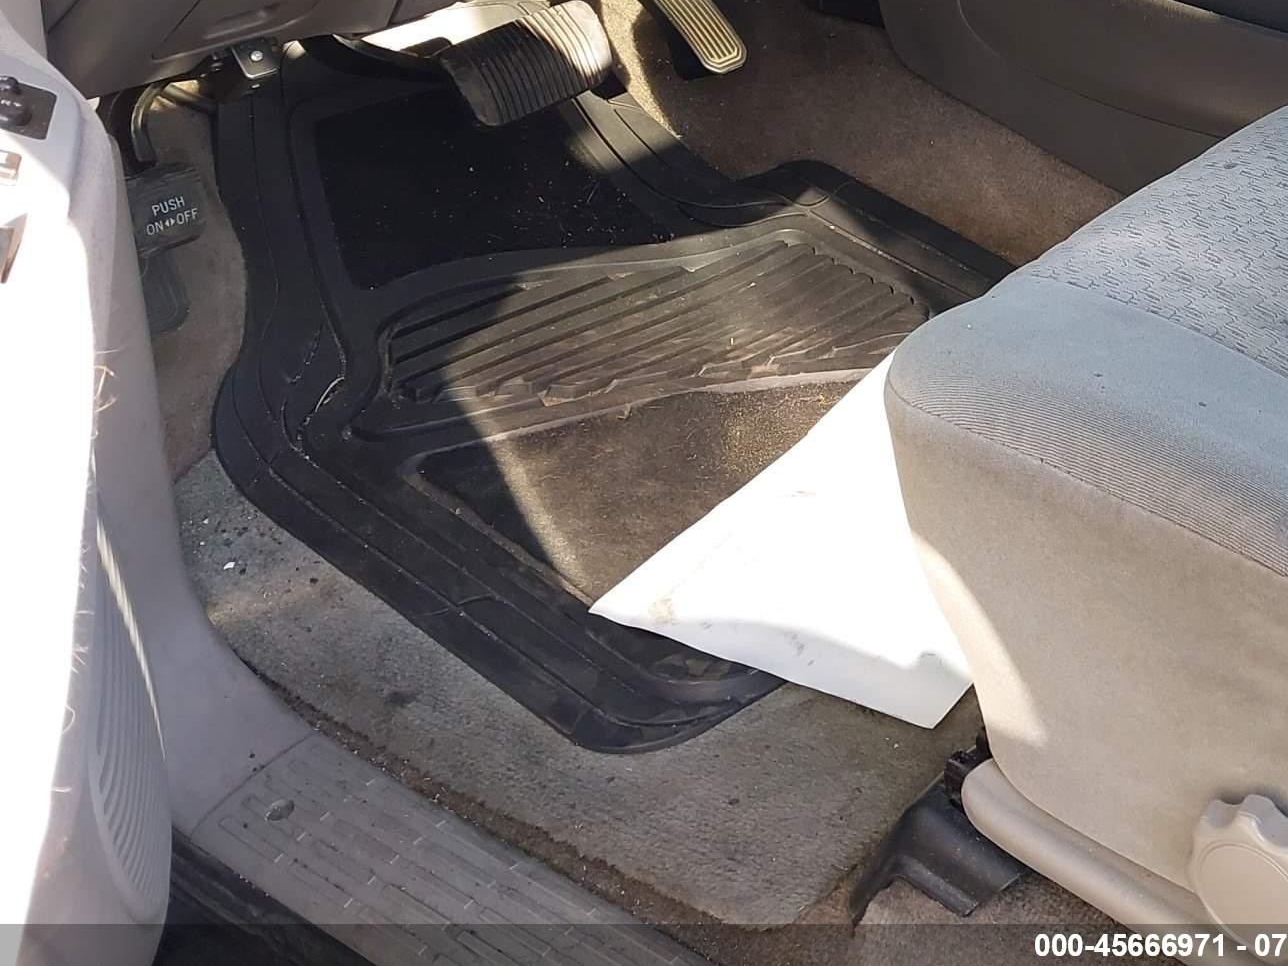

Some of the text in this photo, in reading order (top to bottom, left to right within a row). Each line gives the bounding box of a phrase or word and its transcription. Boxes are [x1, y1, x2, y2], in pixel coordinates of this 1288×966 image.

[151, 195, 186, 217] PUSH
[146, 207, 199, 236] ON OFF
